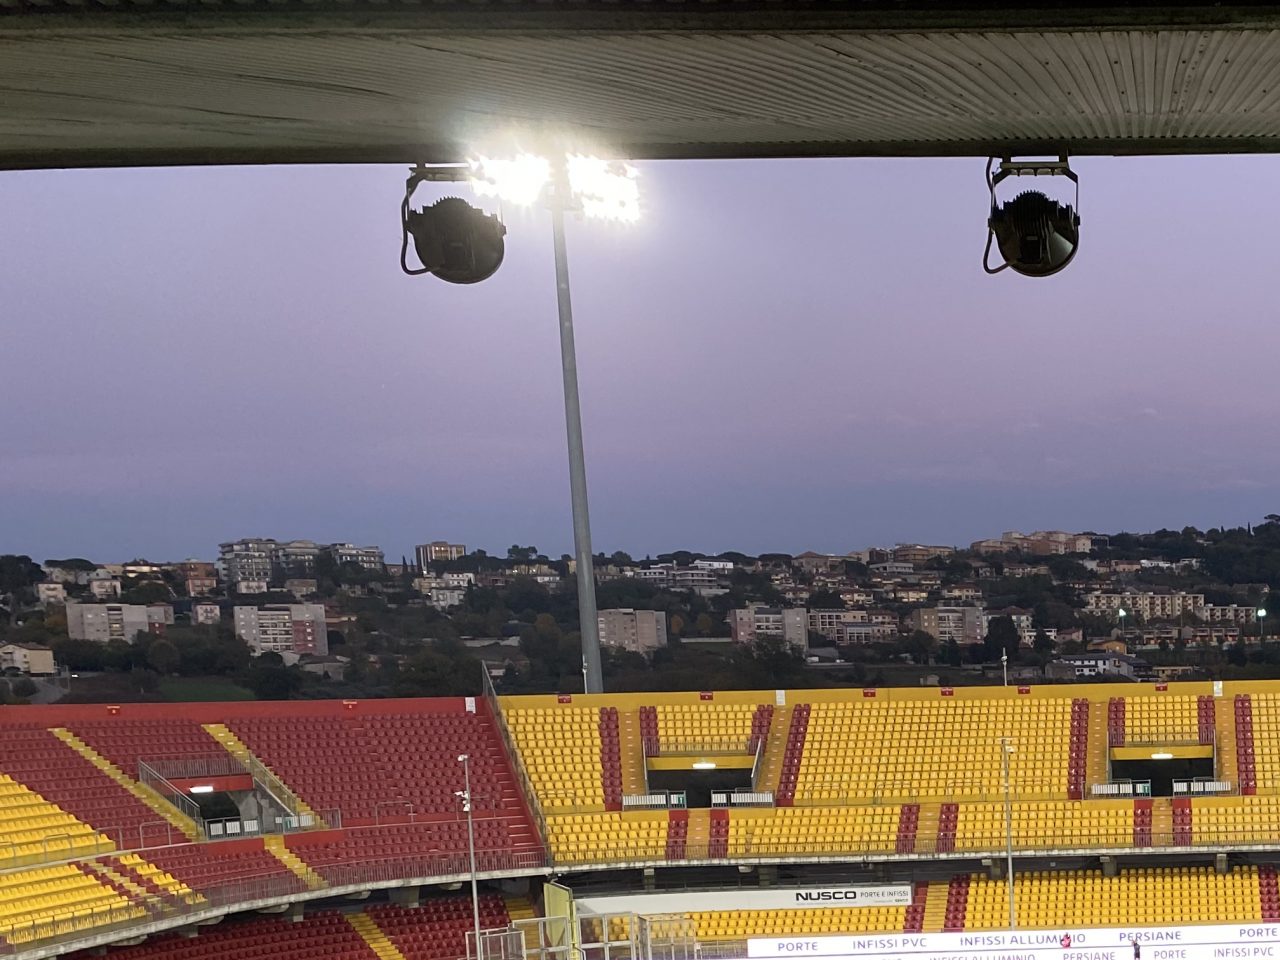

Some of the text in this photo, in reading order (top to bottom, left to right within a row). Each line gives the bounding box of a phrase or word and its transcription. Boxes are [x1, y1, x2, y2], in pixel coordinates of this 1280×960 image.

[796, 891, 856, 901] NUSCO
[778, 942, 818, 952] PORTE
[853, 939, 898, 950] INFISSI
[902, 938, 927, 948] PVC
[960, 936, 1005, 946] INFISSI
[1010, 934, 1086, 945] ALLUMIIO
[1119, 931, 1182, 942] PERSIANE
[1239, 928, 1278, 938] PORTE
[1154, 949, 1187, 960] PORTE
[1214, 947, 1250, 958] INFISSI
[1253, 946, 1274, 956] PVC
